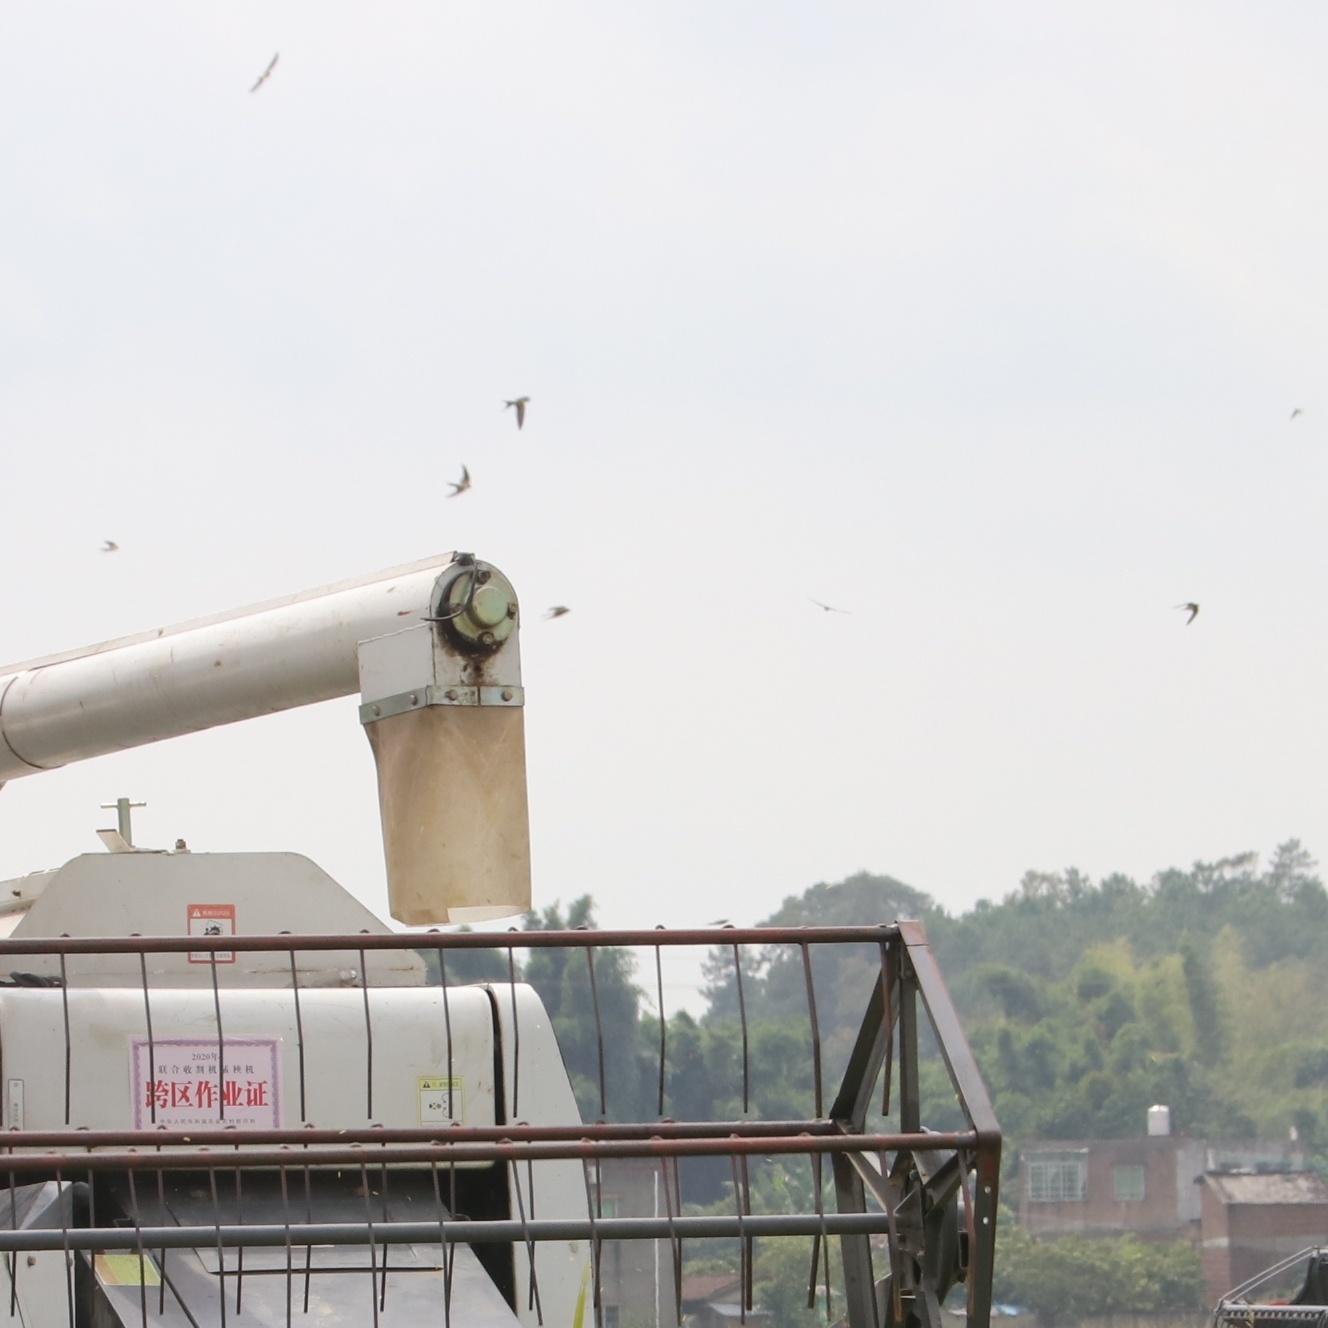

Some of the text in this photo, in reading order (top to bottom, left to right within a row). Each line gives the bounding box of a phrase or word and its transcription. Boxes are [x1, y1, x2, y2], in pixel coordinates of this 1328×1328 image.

[145, 1080, 269, 1109] 跨区作业证
